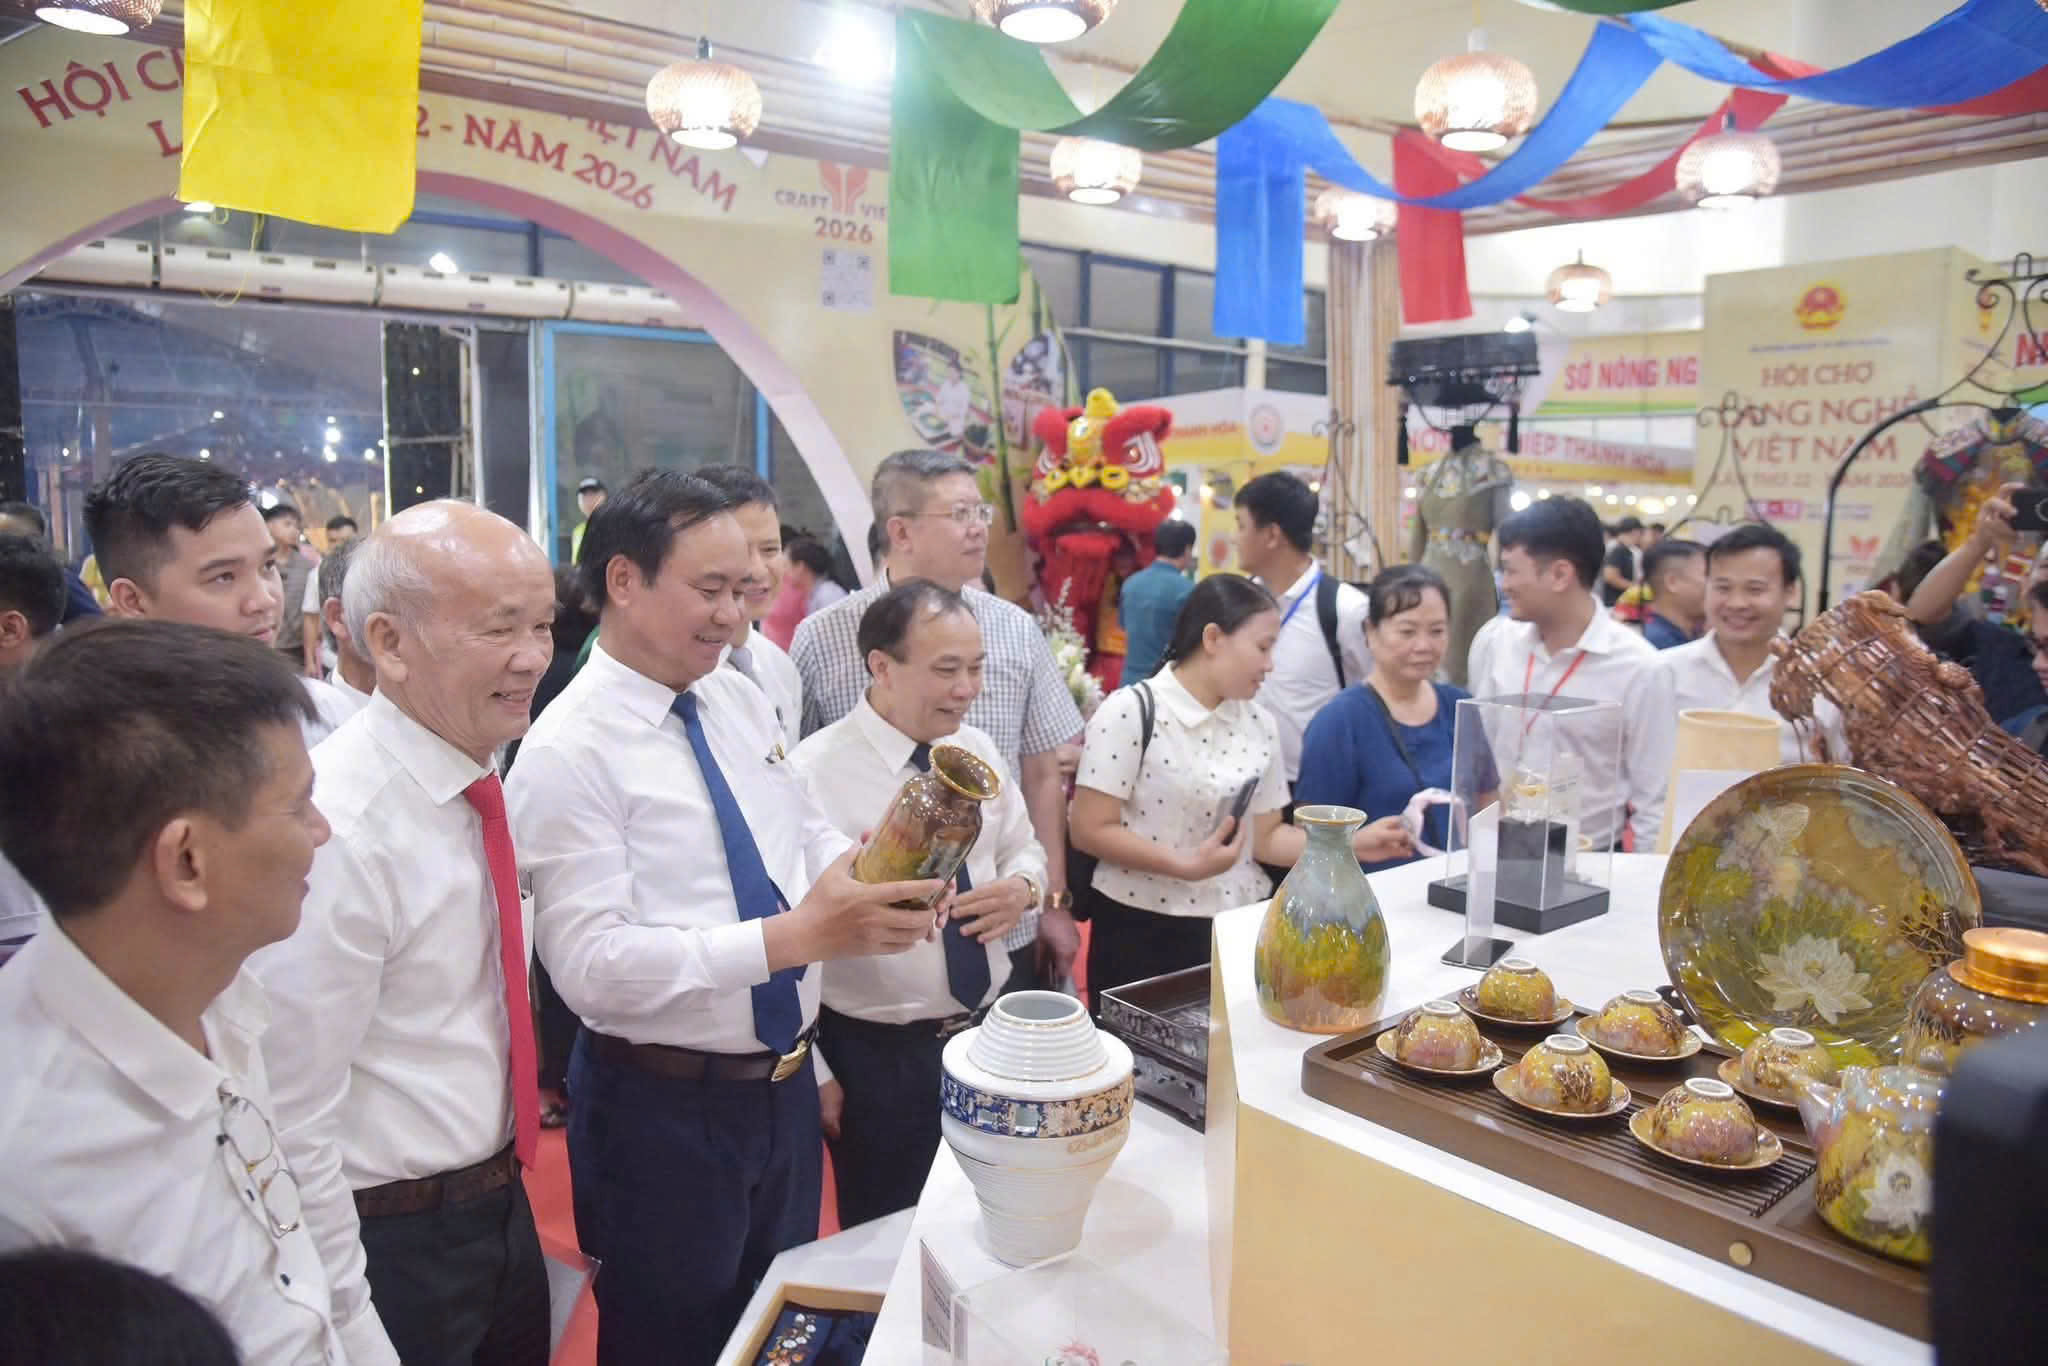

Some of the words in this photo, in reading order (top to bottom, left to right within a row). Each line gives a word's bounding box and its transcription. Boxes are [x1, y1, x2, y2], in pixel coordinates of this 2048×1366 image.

[16, 59, 132, 128] HỘI
[649, 131, 737, 212] NAM
[572, 152, 655, 210] 2026
[775, 189, 829, 210] CRAFT
[815, 216, 874, 244] 2026
